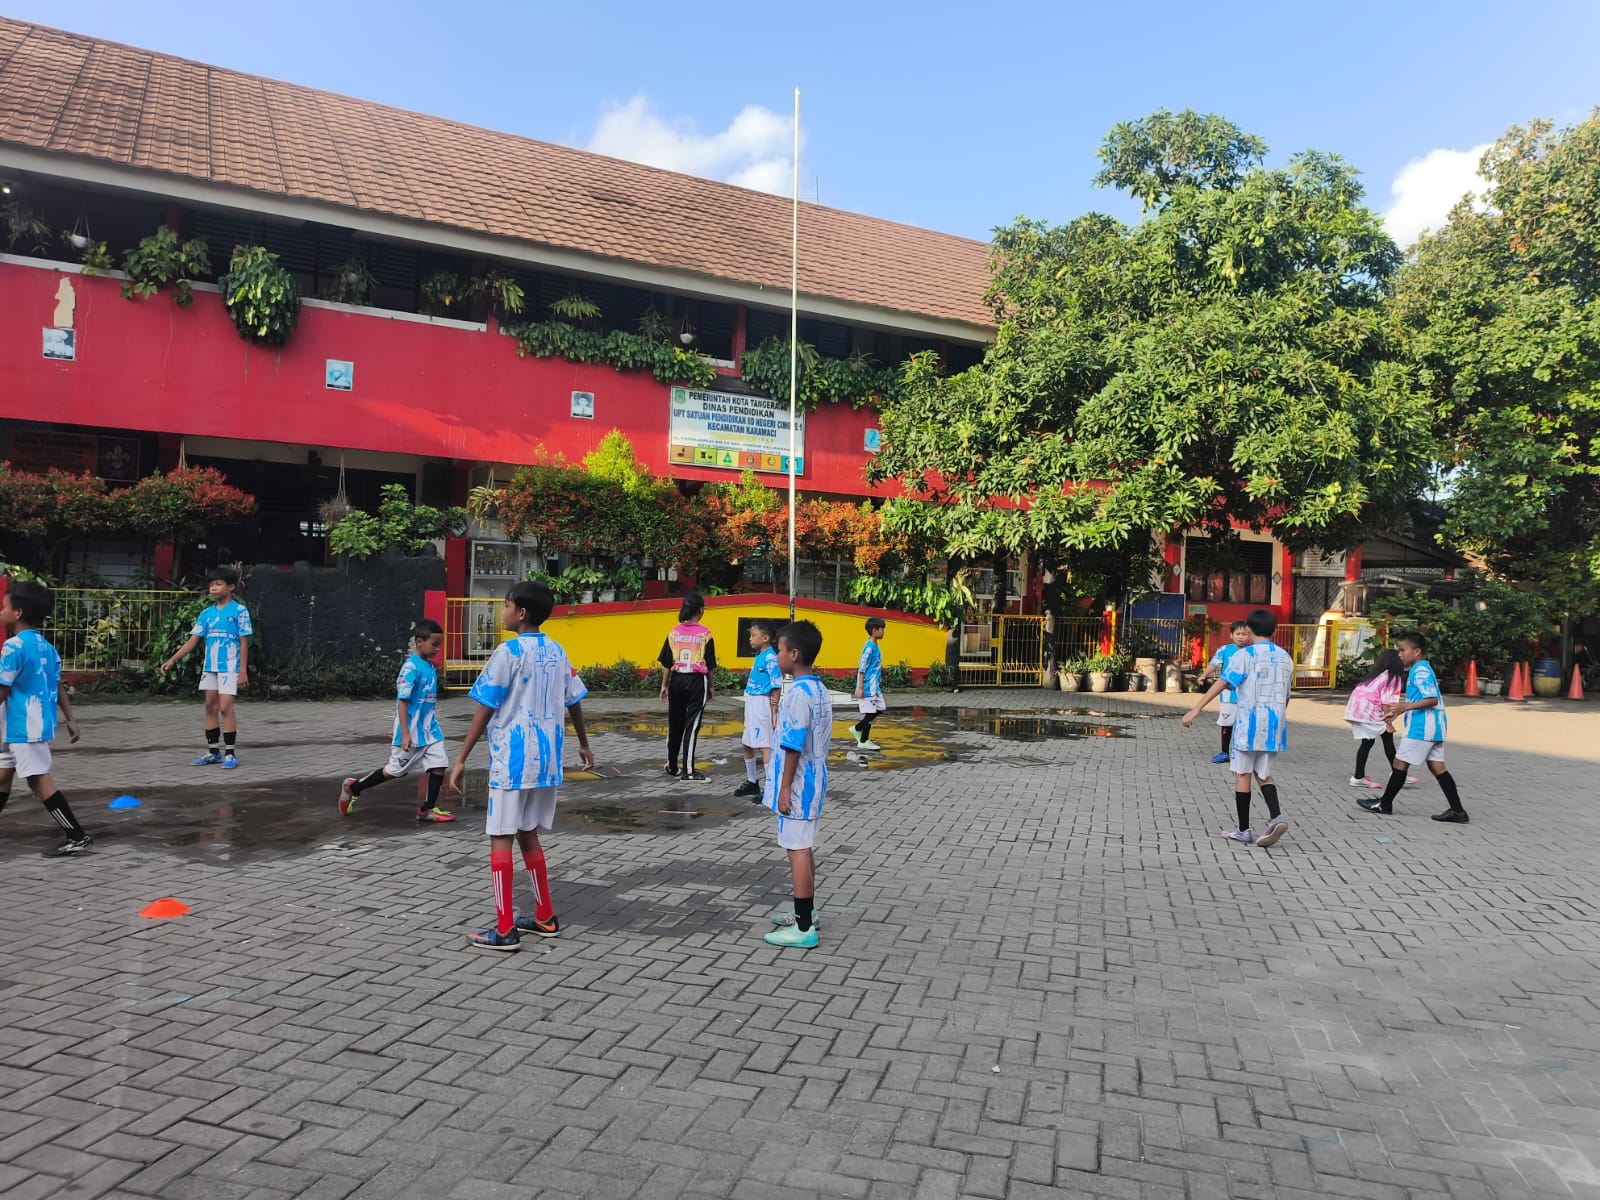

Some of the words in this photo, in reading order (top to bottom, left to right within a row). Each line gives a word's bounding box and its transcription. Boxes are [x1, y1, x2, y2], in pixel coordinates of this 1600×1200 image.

[689, 392, 731, 404] PEMERINTAH
[732, 397, 749, 406] KOTA
[703, 403, 727, 413] DINAS
[729, 406, 775, 418] PENDIDIKAN
[673, 408, 686, 418] UPT
[687, 410, 711, 421] SATUAN
[711, 413, 746, 425] PENDIDIKAN
[747, 417, 755, 426] SD
[756, 418, 776, 429] NEGERI
[708, 422, 744, 434] KECAMATAN
[746, 427, 777, 438] KARAWACI
[679, 648, 692, 673] 9
[222, 675, 229, 686] 7
[754, 727, 761, 739] 7
